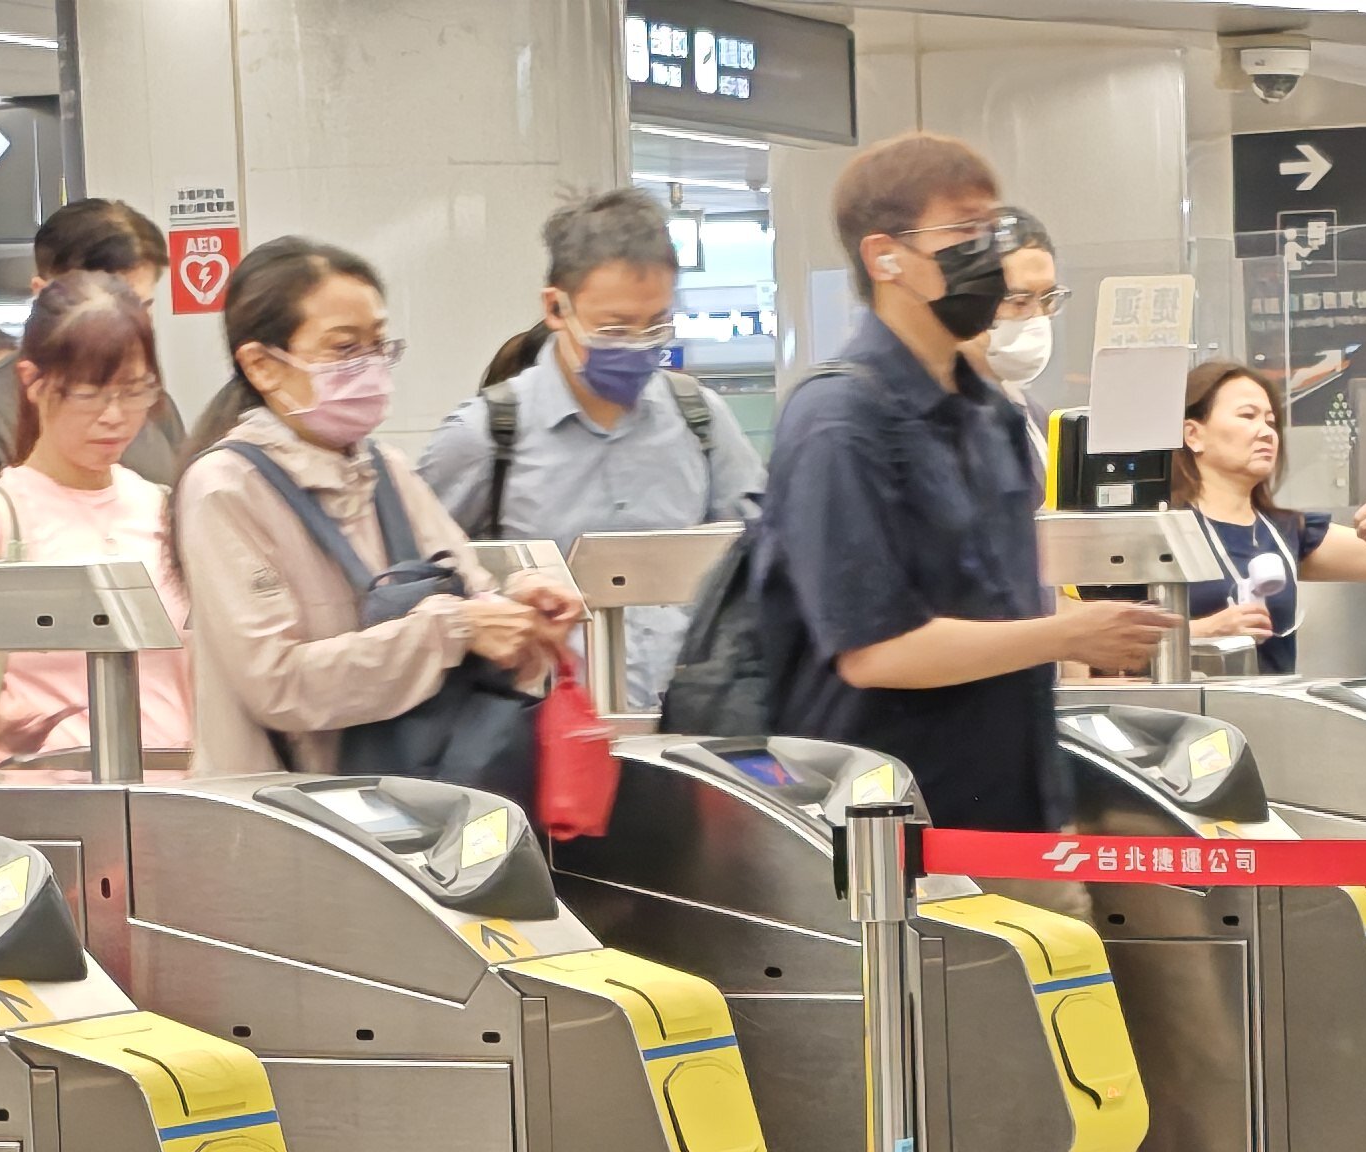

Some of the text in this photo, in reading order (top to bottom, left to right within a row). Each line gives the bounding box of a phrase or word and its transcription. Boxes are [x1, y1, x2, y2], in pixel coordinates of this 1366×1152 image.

[186, 236, 222, 254] AED
[1097, 846, 1256, 875] 台北捷運公司
